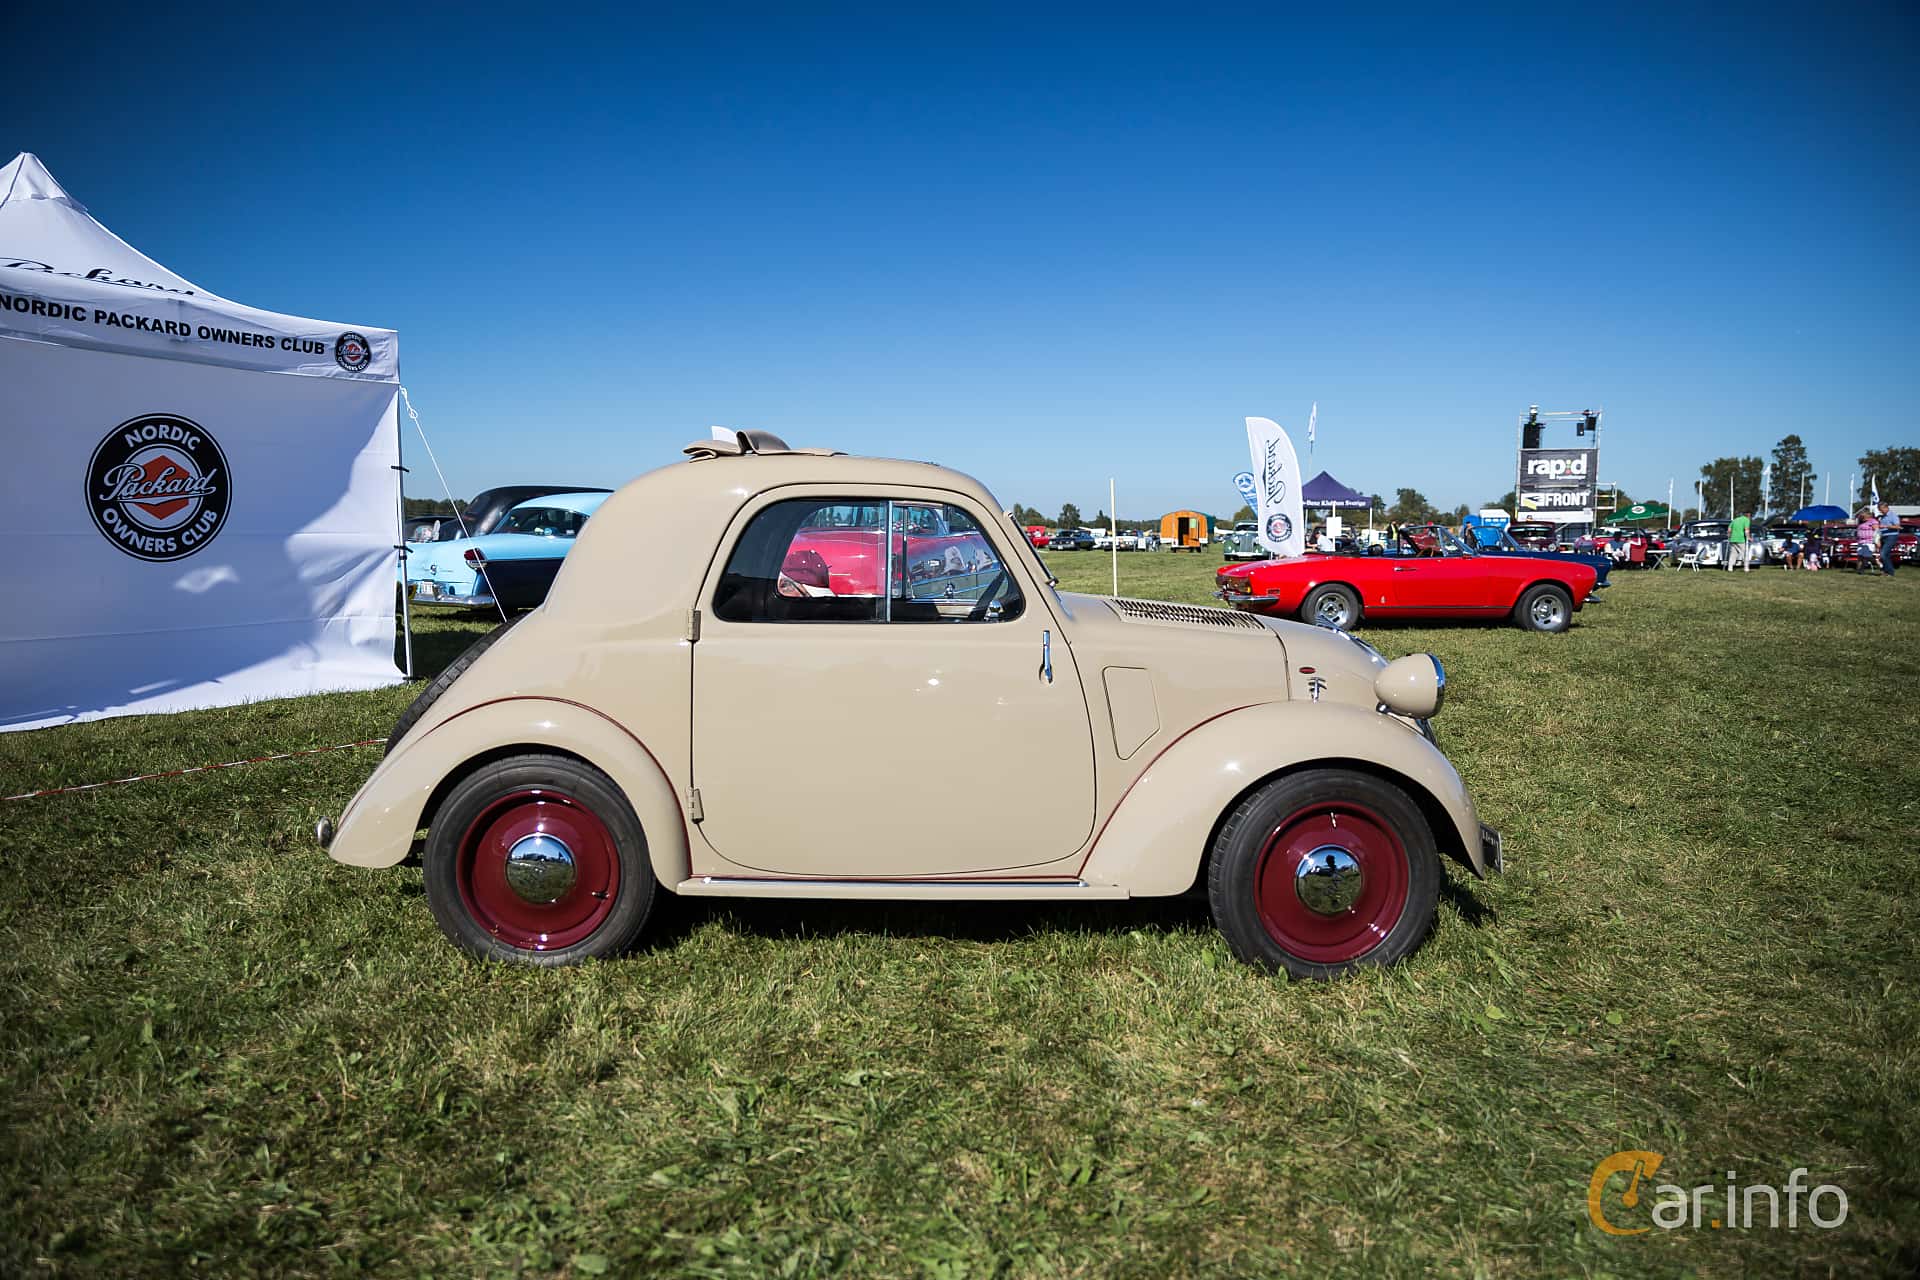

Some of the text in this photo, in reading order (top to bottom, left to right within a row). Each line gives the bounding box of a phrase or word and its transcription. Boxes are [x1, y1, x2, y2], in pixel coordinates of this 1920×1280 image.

[0, 294, 326, 355] NORDIC PACKARD OWNERS CLUB
[124, 424, 201, 451] NORDIC
[99, 462, 218, 504] Packard
[1545, 492, 1589, 506] FRONT
[102, 508, 218, 553] OWNERS CLUB
